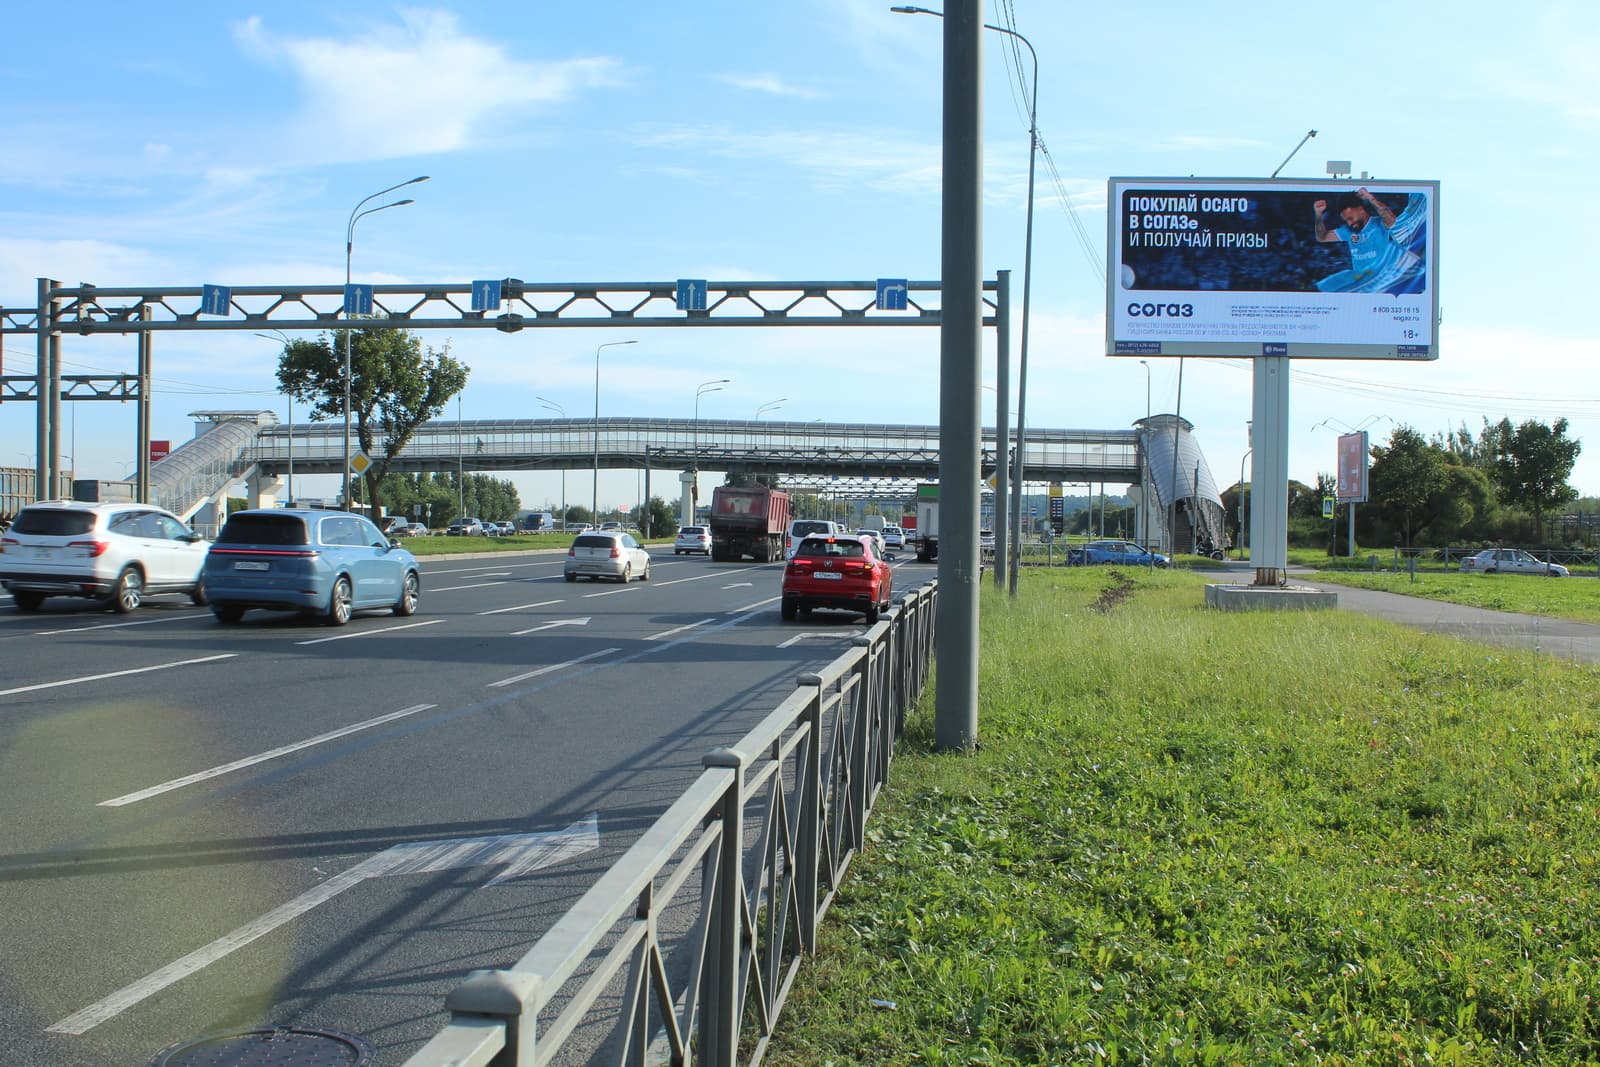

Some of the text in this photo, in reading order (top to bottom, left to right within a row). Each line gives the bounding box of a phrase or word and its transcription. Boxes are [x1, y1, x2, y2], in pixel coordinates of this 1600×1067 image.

[1129, 194, 1248, 213] ПОКУПАЙ ОСАГО
[1129, 214, 1199, 230] В СОГАЗе
[1129, 229, 1268, 248] И ПОЛУЧАЙ ПРИЗЫ
[1127, 302, 1194, 317] согаз
[1403, 329, 1419, 339] 18+
